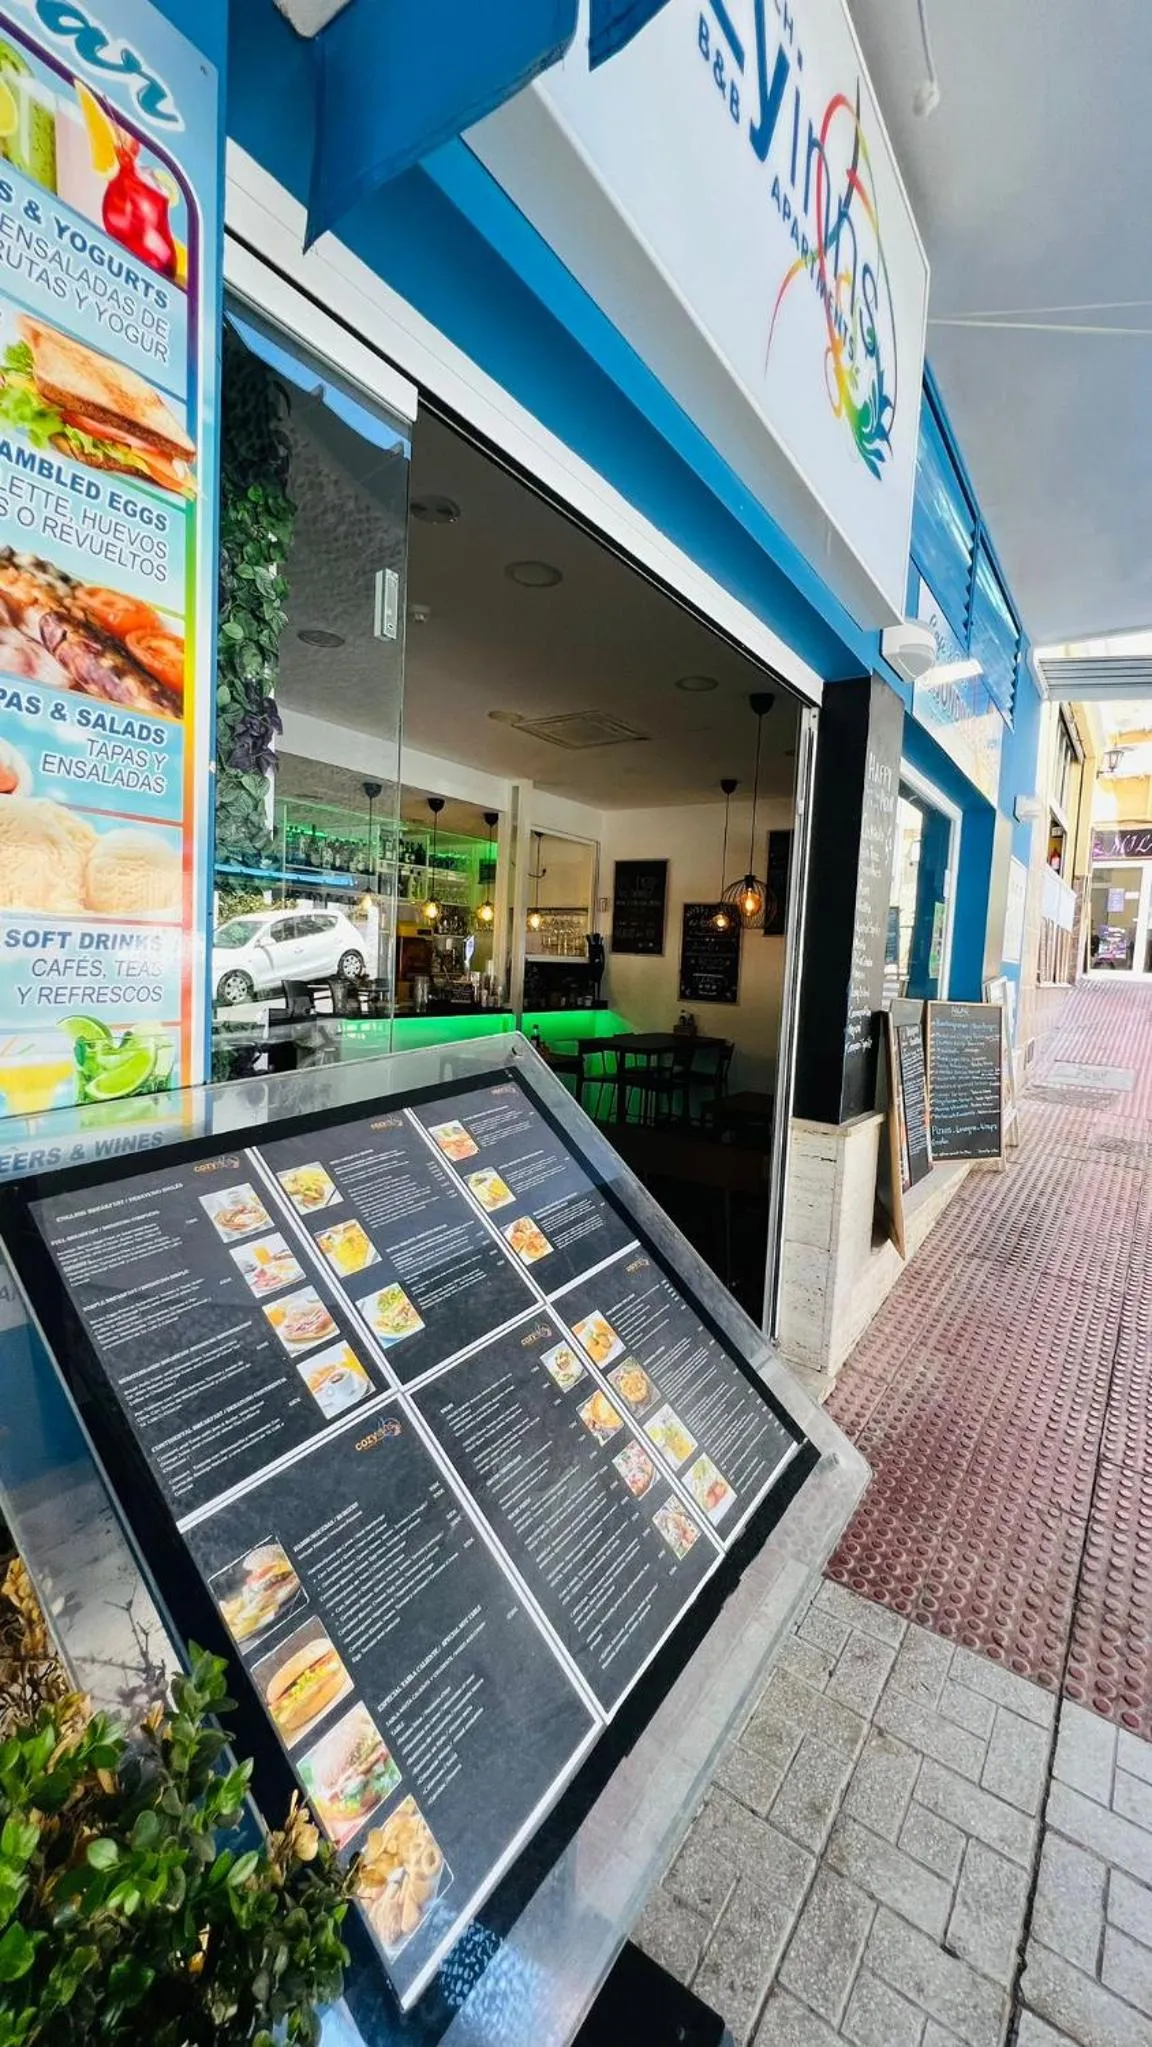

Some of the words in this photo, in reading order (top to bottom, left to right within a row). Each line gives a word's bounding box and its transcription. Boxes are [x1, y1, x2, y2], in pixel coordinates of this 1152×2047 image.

[698, 11, 740, 126] B&B
[0, 212, 136, 319] ENSALADAS
[141, 308, 168, 340] DE
[23, 199, 42, 225] &
[54, 216, 169, 309] YOGURTS
[75, 287, 89, 311] Y
[95, 301, 168, 364] YOGUR
[0, 439, 101, 501] AMBLED
[108, 491, 168, 532] EGGS
[17, 506, 35, 527] O
[42, 516, 168, 582] REVUELTOS
[82, 507, 168, 560] HUEVOS
[50, 702, 67, 722] &
[76, 709, 166, 745] SALADS
[42, 753, 165, 794] ENSALADAS
[87, 738, 149, 769] TAPAS
[154, 754, 167, 771] Y
[5, 928, 72, 949] SOFT
[79, 932, 162, 951] DRINKS
[32, 955, 107, 979] CAFÉS,
[115, 960, 163, 978] TEAS
[17, 987, 32, 1005] Y
[37, 986, 163, 1005] REFRESCOS
[69, 1143, 86, 1162] &
[95, 1131, 165, 1157] WINES
